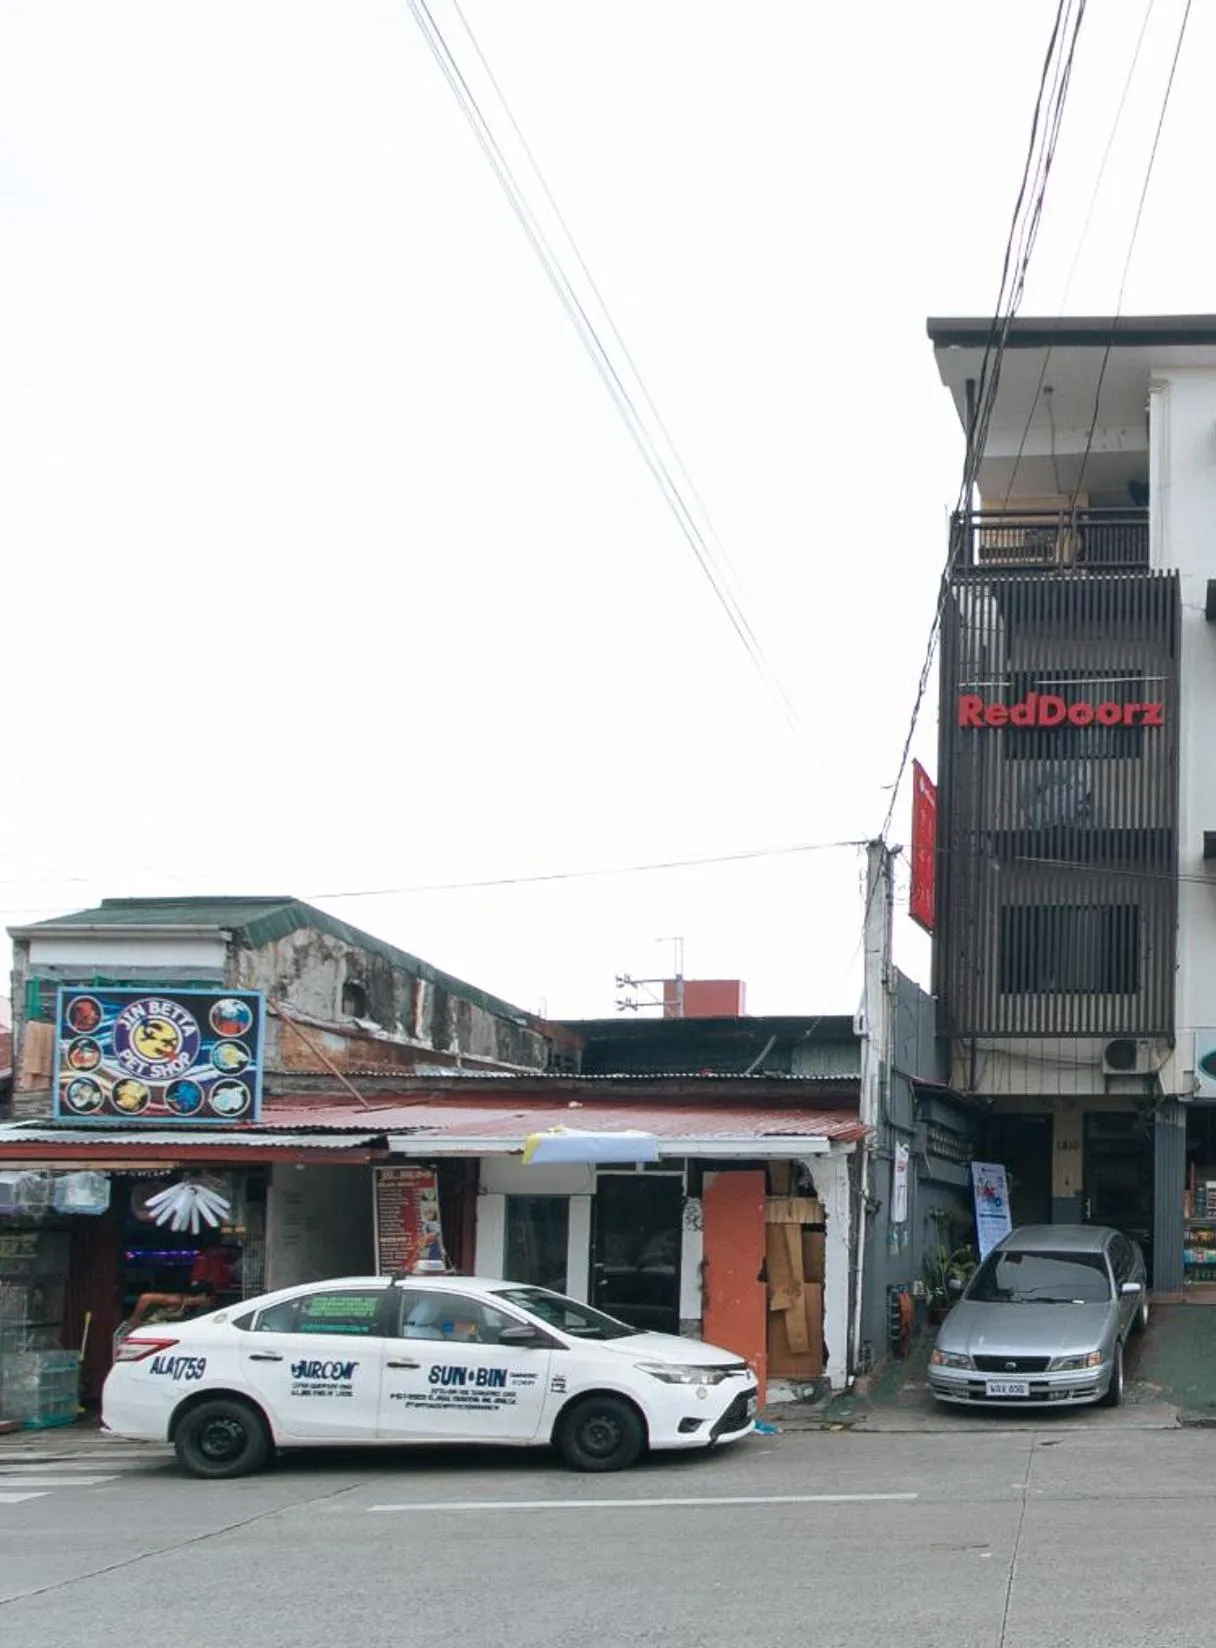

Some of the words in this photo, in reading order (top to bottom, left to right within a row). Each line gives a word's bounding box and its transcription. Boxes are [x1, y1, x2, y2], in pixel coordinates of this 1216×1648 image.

[958, 691, 1165, 726] RedDoorz
[120, 1003, 147, 1030] JIN
[149, 1001, 197, 1037] BETTA
[119, 1048, 150, 1074] PET
[149, 1051, 191, 1078] SHOP
